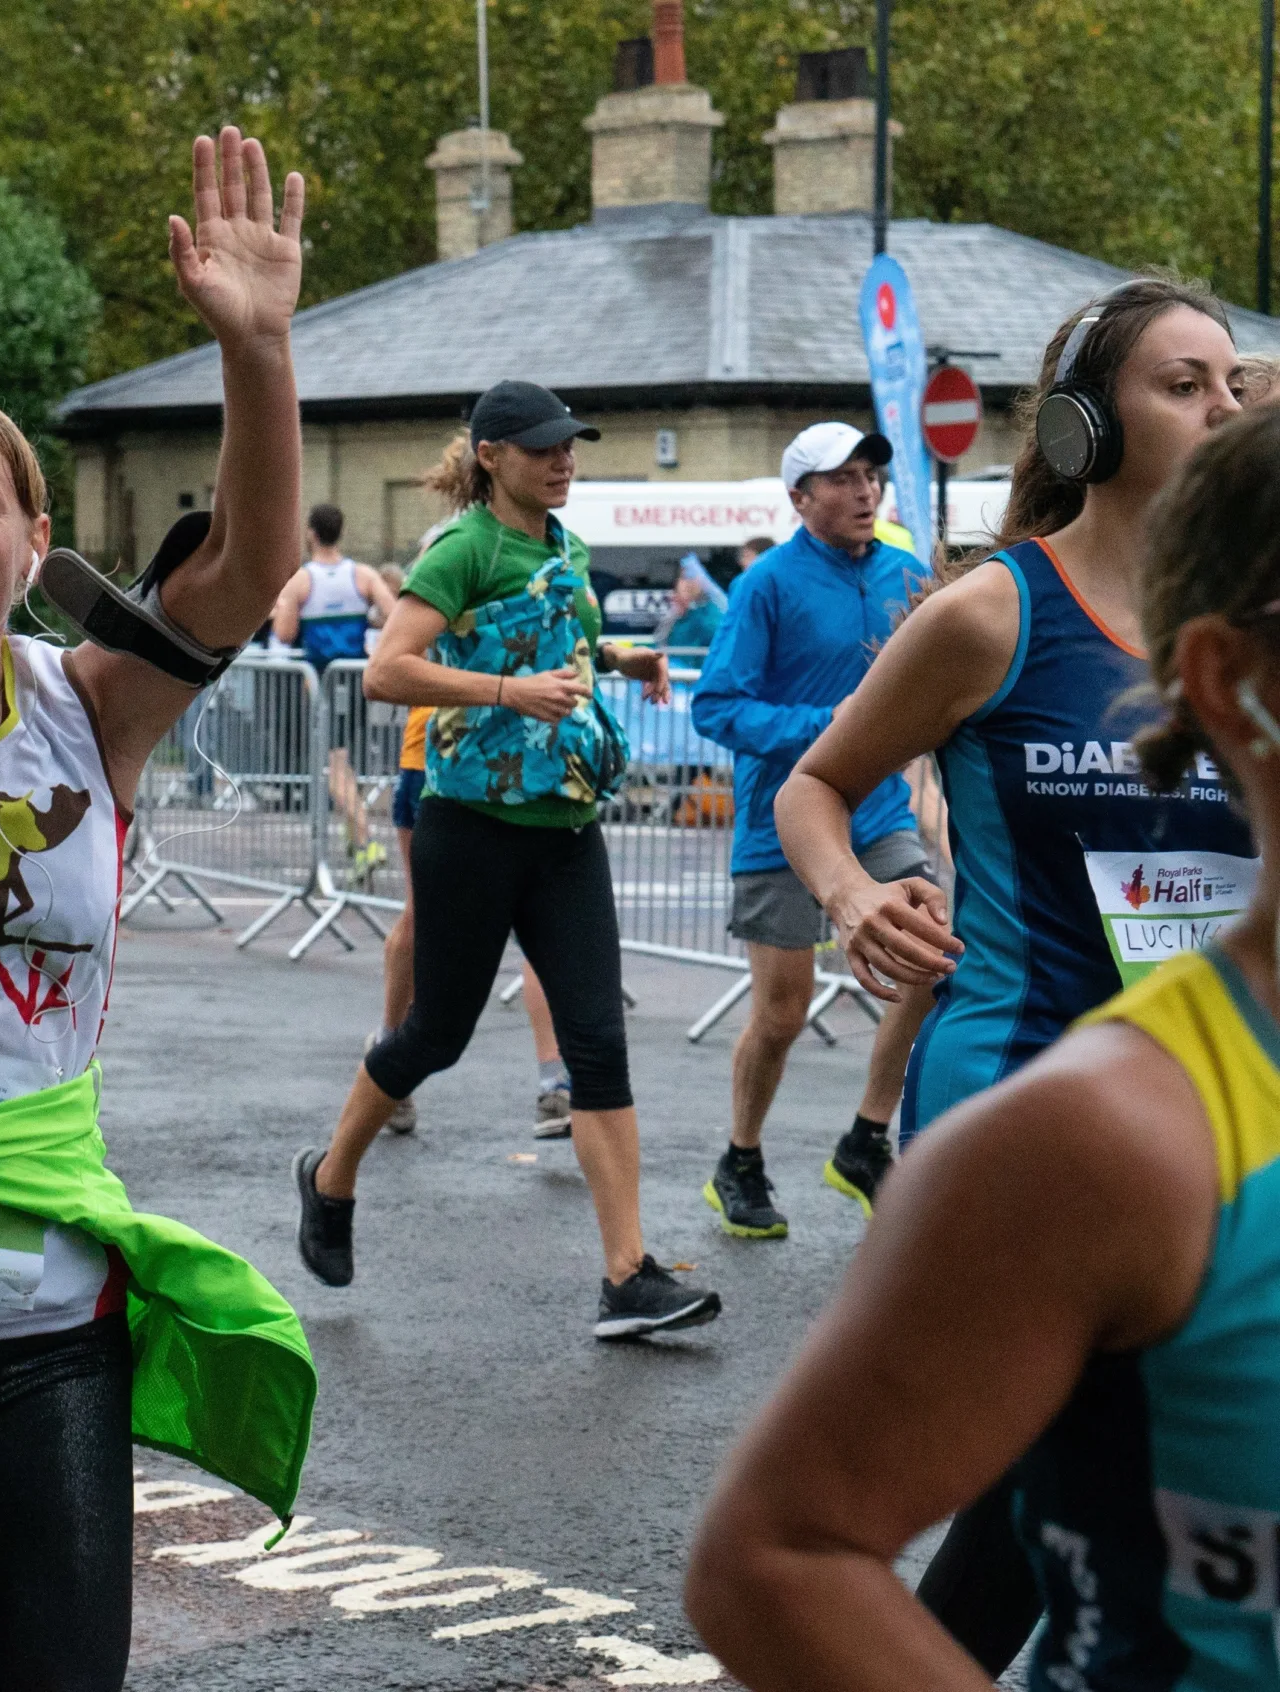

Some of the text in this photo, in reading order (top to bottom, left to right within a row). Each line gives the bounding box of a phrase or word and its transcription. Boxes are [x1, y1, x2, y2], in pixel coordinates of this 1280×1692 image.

[614, 504, 779, 528] EMERGENCY
[1024, 741, 1220, 780] DiABE
[1027, 781, 1088, 797] KNOW
[1094, 782, 1185, 799] DIABES.
[1157, 866, 1203, 880] Royal Parks
[1153, 879, 1202, 903] Half
[1125, 921, 1222, 952] LUCIN
[151, 1515, 637, 1641] LOOK
